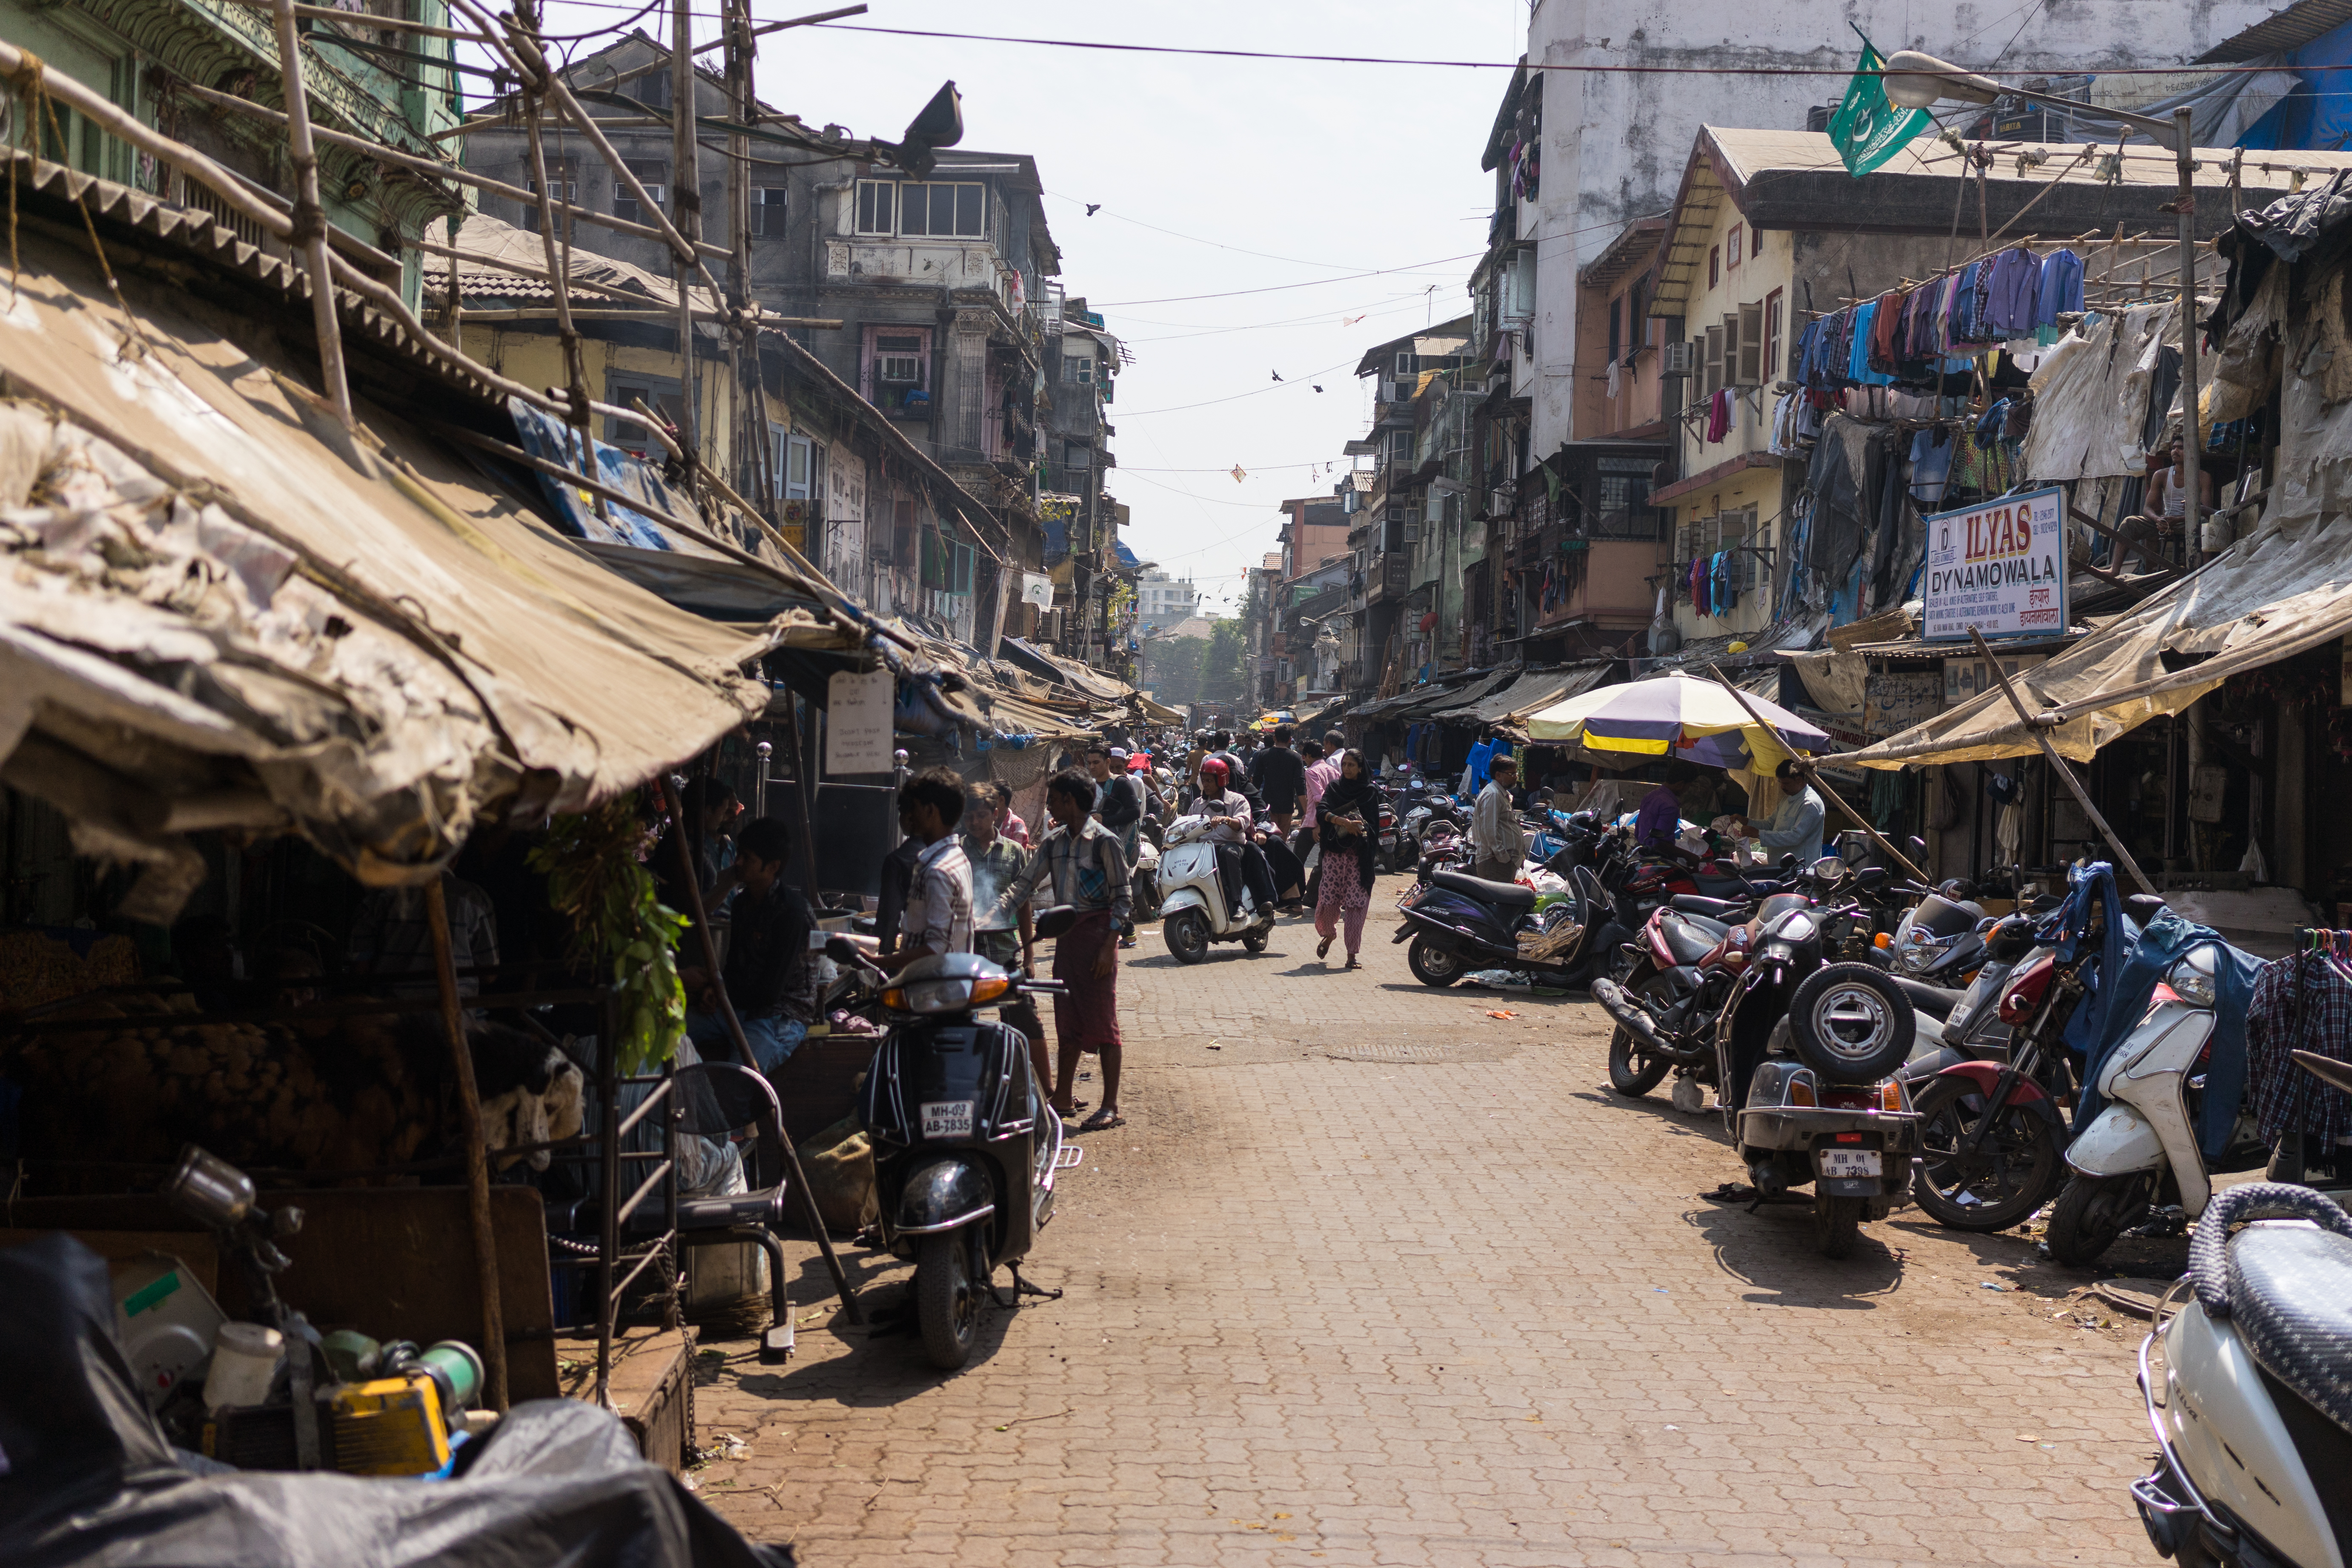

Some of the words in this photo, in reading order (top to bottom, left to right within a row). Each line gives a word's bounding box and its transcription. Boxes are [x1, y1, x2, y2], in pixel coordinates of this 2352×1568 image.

[1965, 502, 2032, 563] ILYAS
[1932, 555, 2057, 594] DYNAMOWALA
[1929, 597, 1938, 608] DEALER
[1419, 906, 1450, 915] Activa
[1917, 922, 1935, 932] HONDA
[1730, 938, 1743, 946] HONDA
[1893, 965, 1903, 973] MH
[926, 1119, 970, 1132] AB-7835
[1833, 1154, 1848, 1164] MH
[1856, 1154, 1865, 1163] 01
[1825, 1166, 1837, 1175] AB
[2172, 1379, 2198, 1422] ctiva
